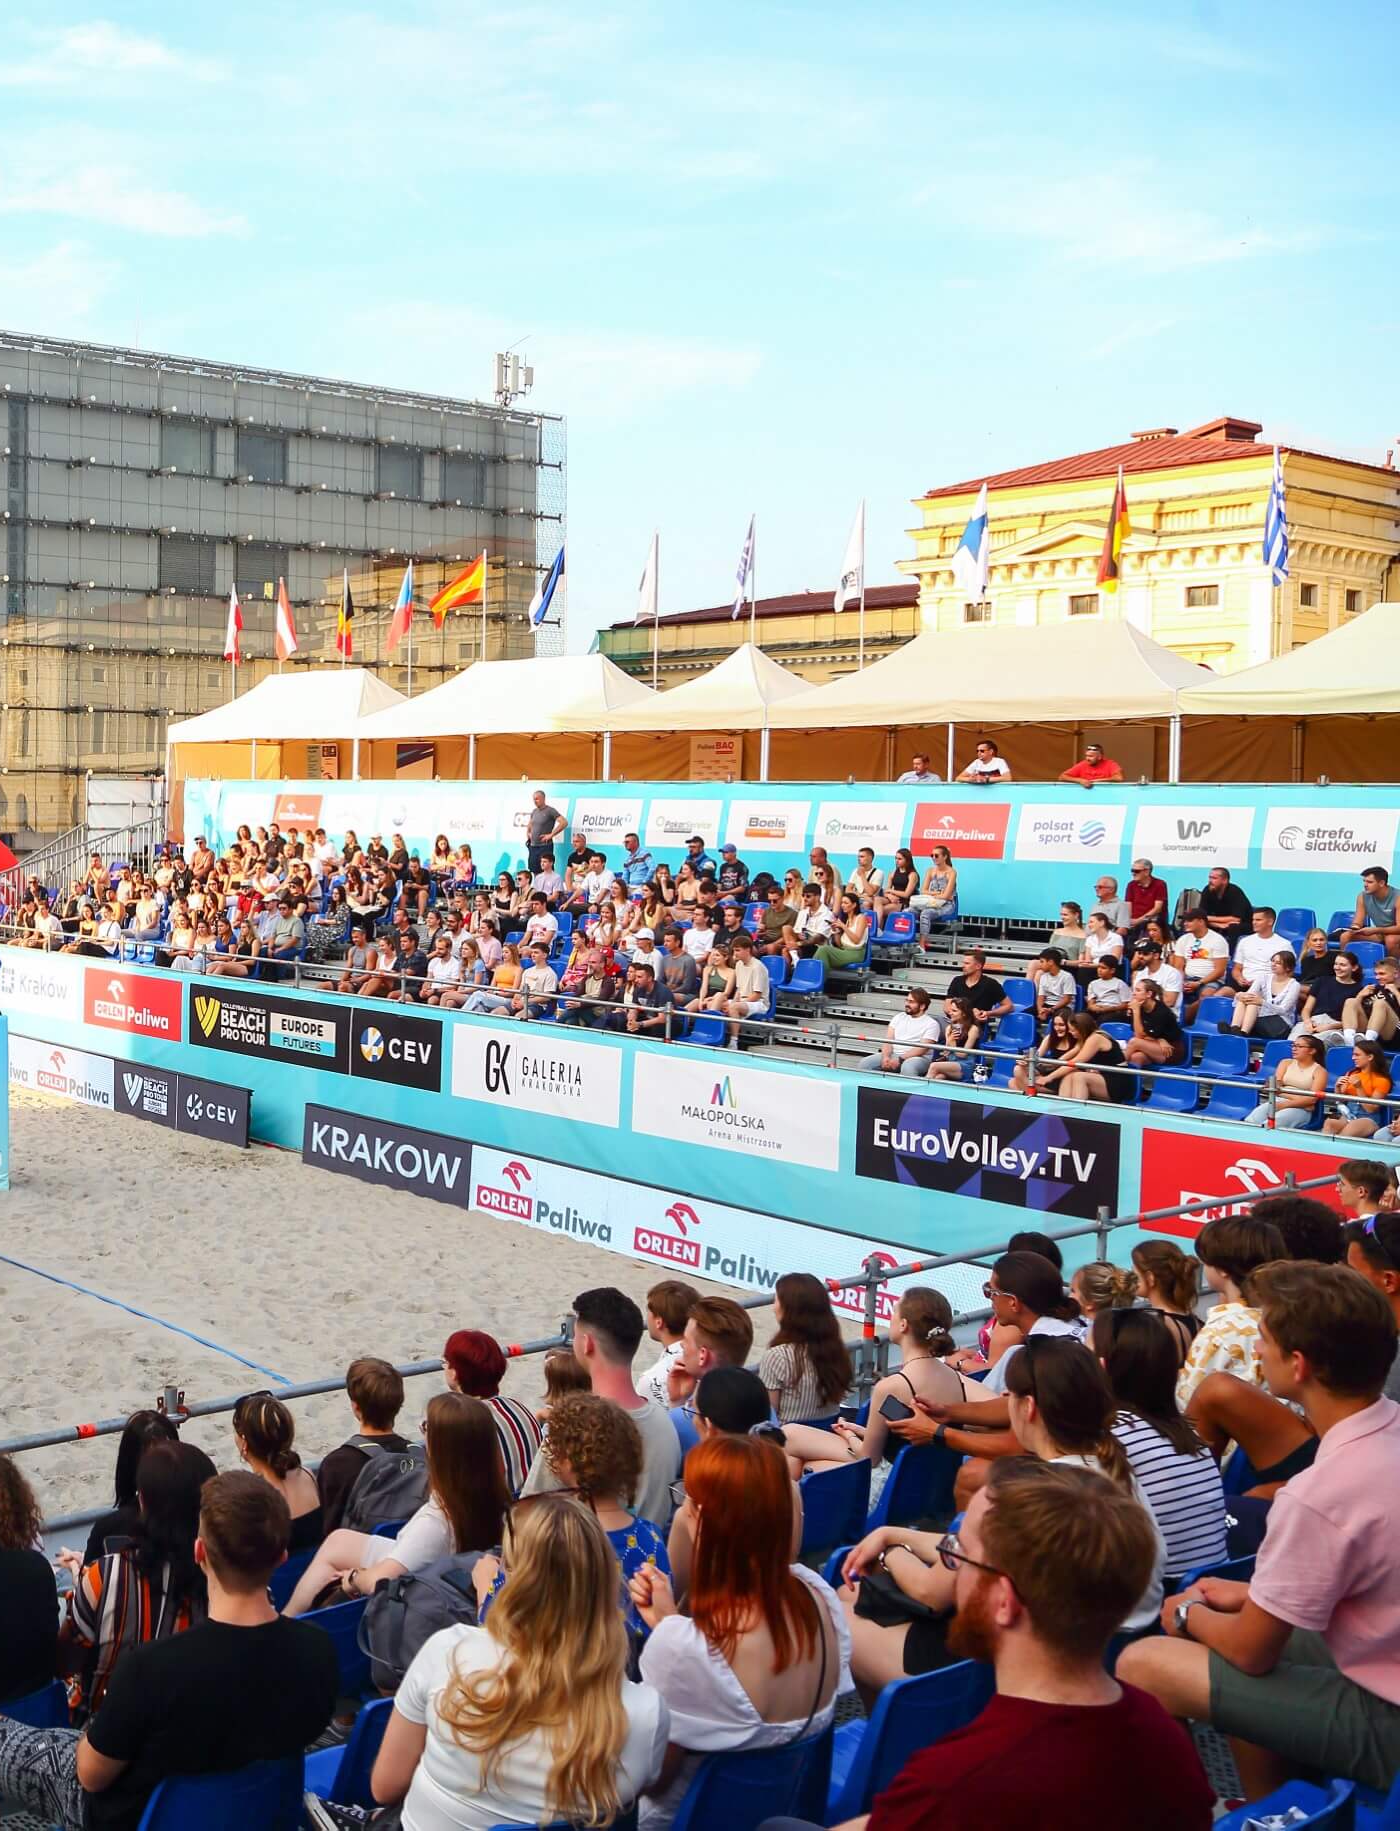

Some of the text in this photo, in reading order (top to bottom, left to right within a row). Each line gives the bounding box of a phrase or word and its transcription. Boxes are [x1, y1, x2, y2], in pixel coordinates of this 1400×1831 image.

[582, 814, 623, 827] Polbruk
[748, 817, 786, 828] Boels
[842, 823, 875, 832] Kruszywo
[1033, 819, 1075, 832] polsat
[1177, 819, 1211, 841] WP
[955, 828, 995, 841] Paliwa
[1038, 832, 1072, 845] sport
[1306, 827, 1354, 839] strefa
[1304, 839, 1377, 852] siatkówki
[18, 974, 68, 999] Kraków
[96, 1002, 169, 1030] ORLEN Paliwa
[221, 1002, 267, 1014] VOLLEYBALL WORLD
[220, 1008, 266, 1033] BEACH
[280, 1018, 324, 1038] EUROPE
[220, 1026, 266, 1047] PRO TOUR
[282, 1036, 321, 1052] FUTURES
[388, 1037, 432, 1065] CEV
[10, 1062, 28, 1082] iwa
[485, 1039, 511, 1095] GK
[521, 1056, 582, 1085] GALERIA
[38, 1073, 110, 1104] ORLEN Paliwa
[143, 1080, 168, 1095] BEACH
[521, 1077, 582, 1097] KRAKOWSKA
[206, 1103, 237, 1125] CEV
[681, 1104, 766, 1131] MAŁOPOLSKA
[708, 1128, 783, 1150] Arena Mistrzostw
[311, 1121, 462, 1190] KRAKOW
[873, 1118, 1097, 1183] EuroVolley.TV
[479, 1189, 612, 1244] ORLEN Paliwa
[637, 1232, 782, 1289] ORLEN Paliw
